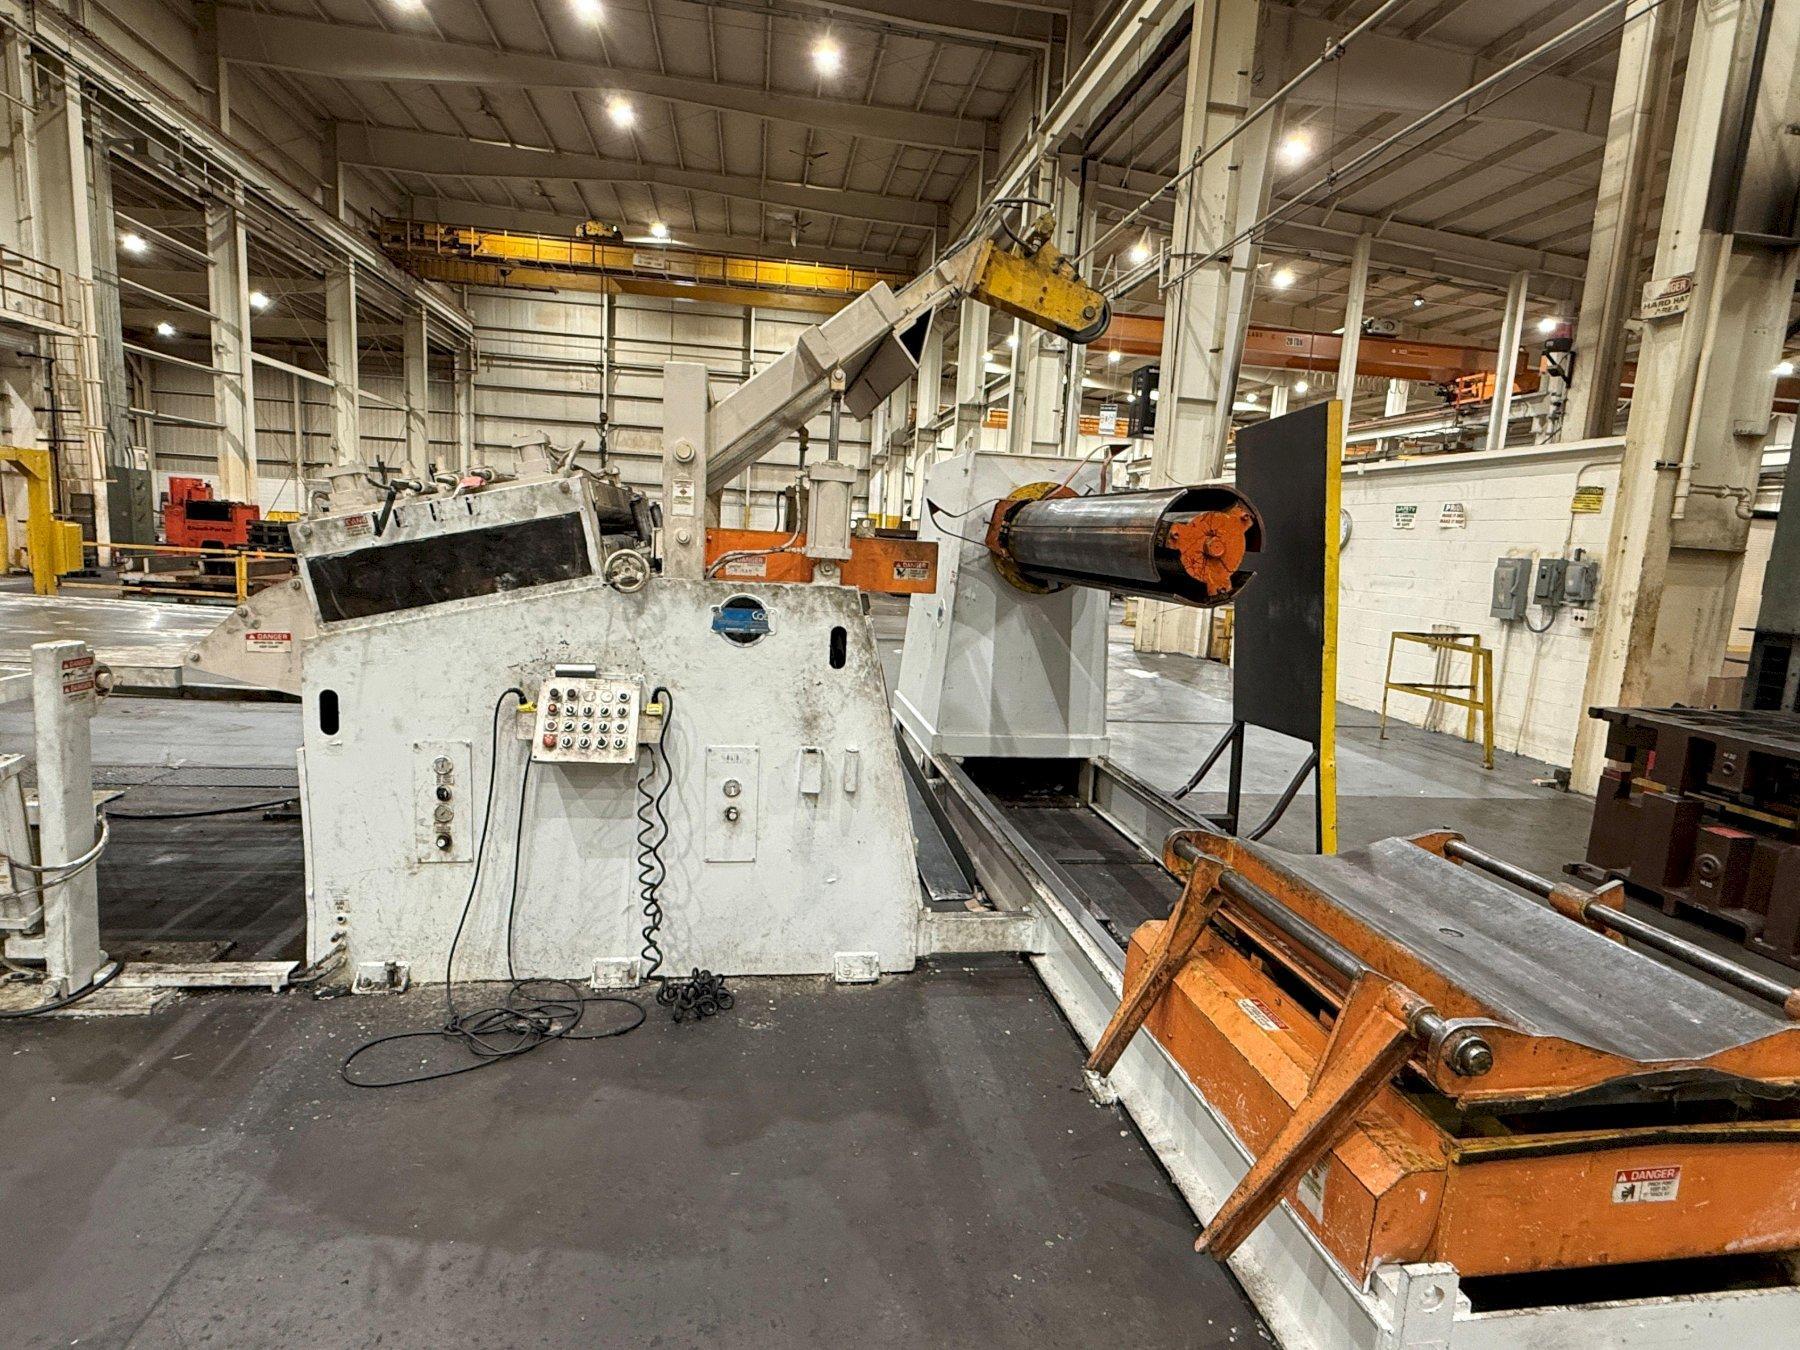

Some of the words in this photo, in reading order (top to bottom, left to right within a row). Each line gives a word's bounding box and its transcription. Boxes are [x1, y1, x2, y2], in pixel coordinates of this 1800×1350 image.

[1643, 299, 1671, 310] HARD
[1674, 294, 1690, 304] HAT
[1654, 305, 1679, 315] AREA
[1631, 1168, 1676, 1180] DANGER
